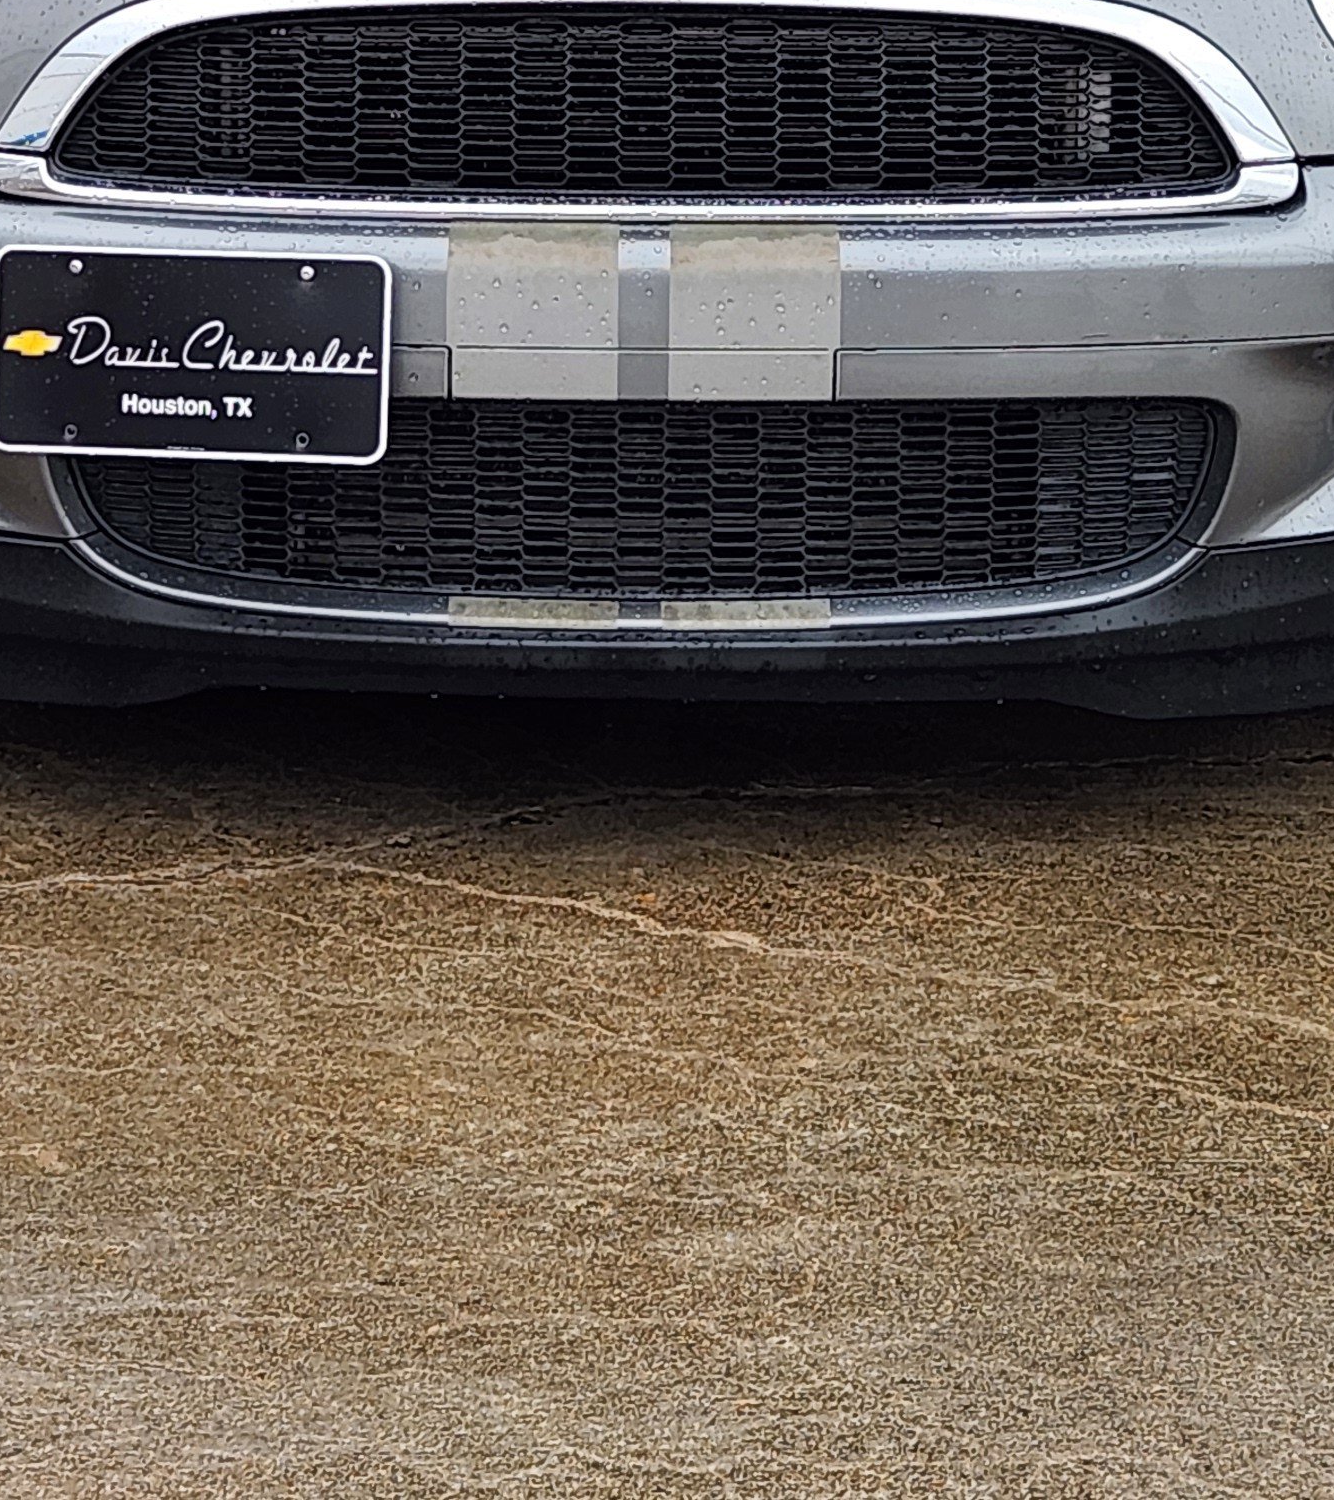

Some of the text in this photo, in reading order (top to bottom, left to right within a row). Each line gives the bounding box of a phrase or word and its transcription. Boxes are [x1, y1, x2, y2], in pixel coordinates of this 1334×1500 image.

[67, 315, 379, 375] Davis Chevrolet
[121, 392, 253, 420] Houston, TX
